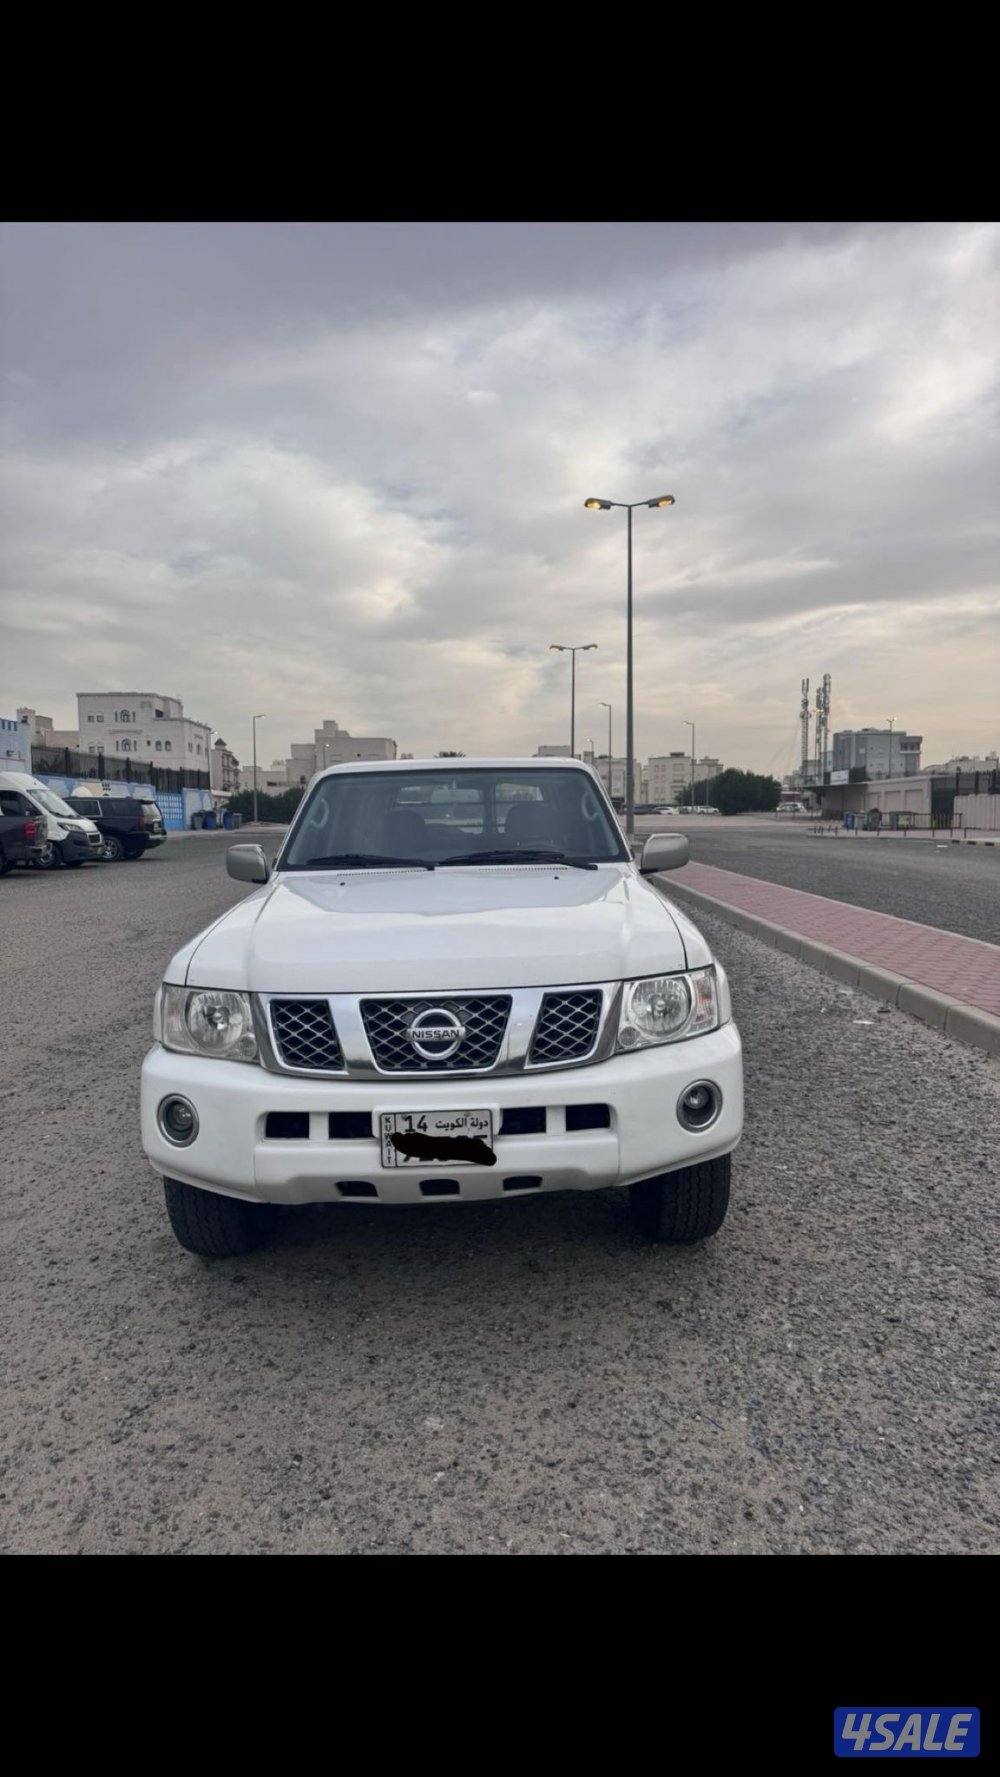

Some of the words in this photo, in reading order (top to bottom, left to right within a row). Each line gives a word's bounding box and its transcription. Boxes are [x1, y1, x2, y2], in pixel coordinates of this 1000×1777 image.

[412, 1029, 460, 1039] NISSAN
[404, 1115, 428, 1133] 14
[435, 1117, 467, 1131] الكويت
[470, 1116, 489, 1130] دولة
[384, 1116, 393, 1164] KUWAIT
